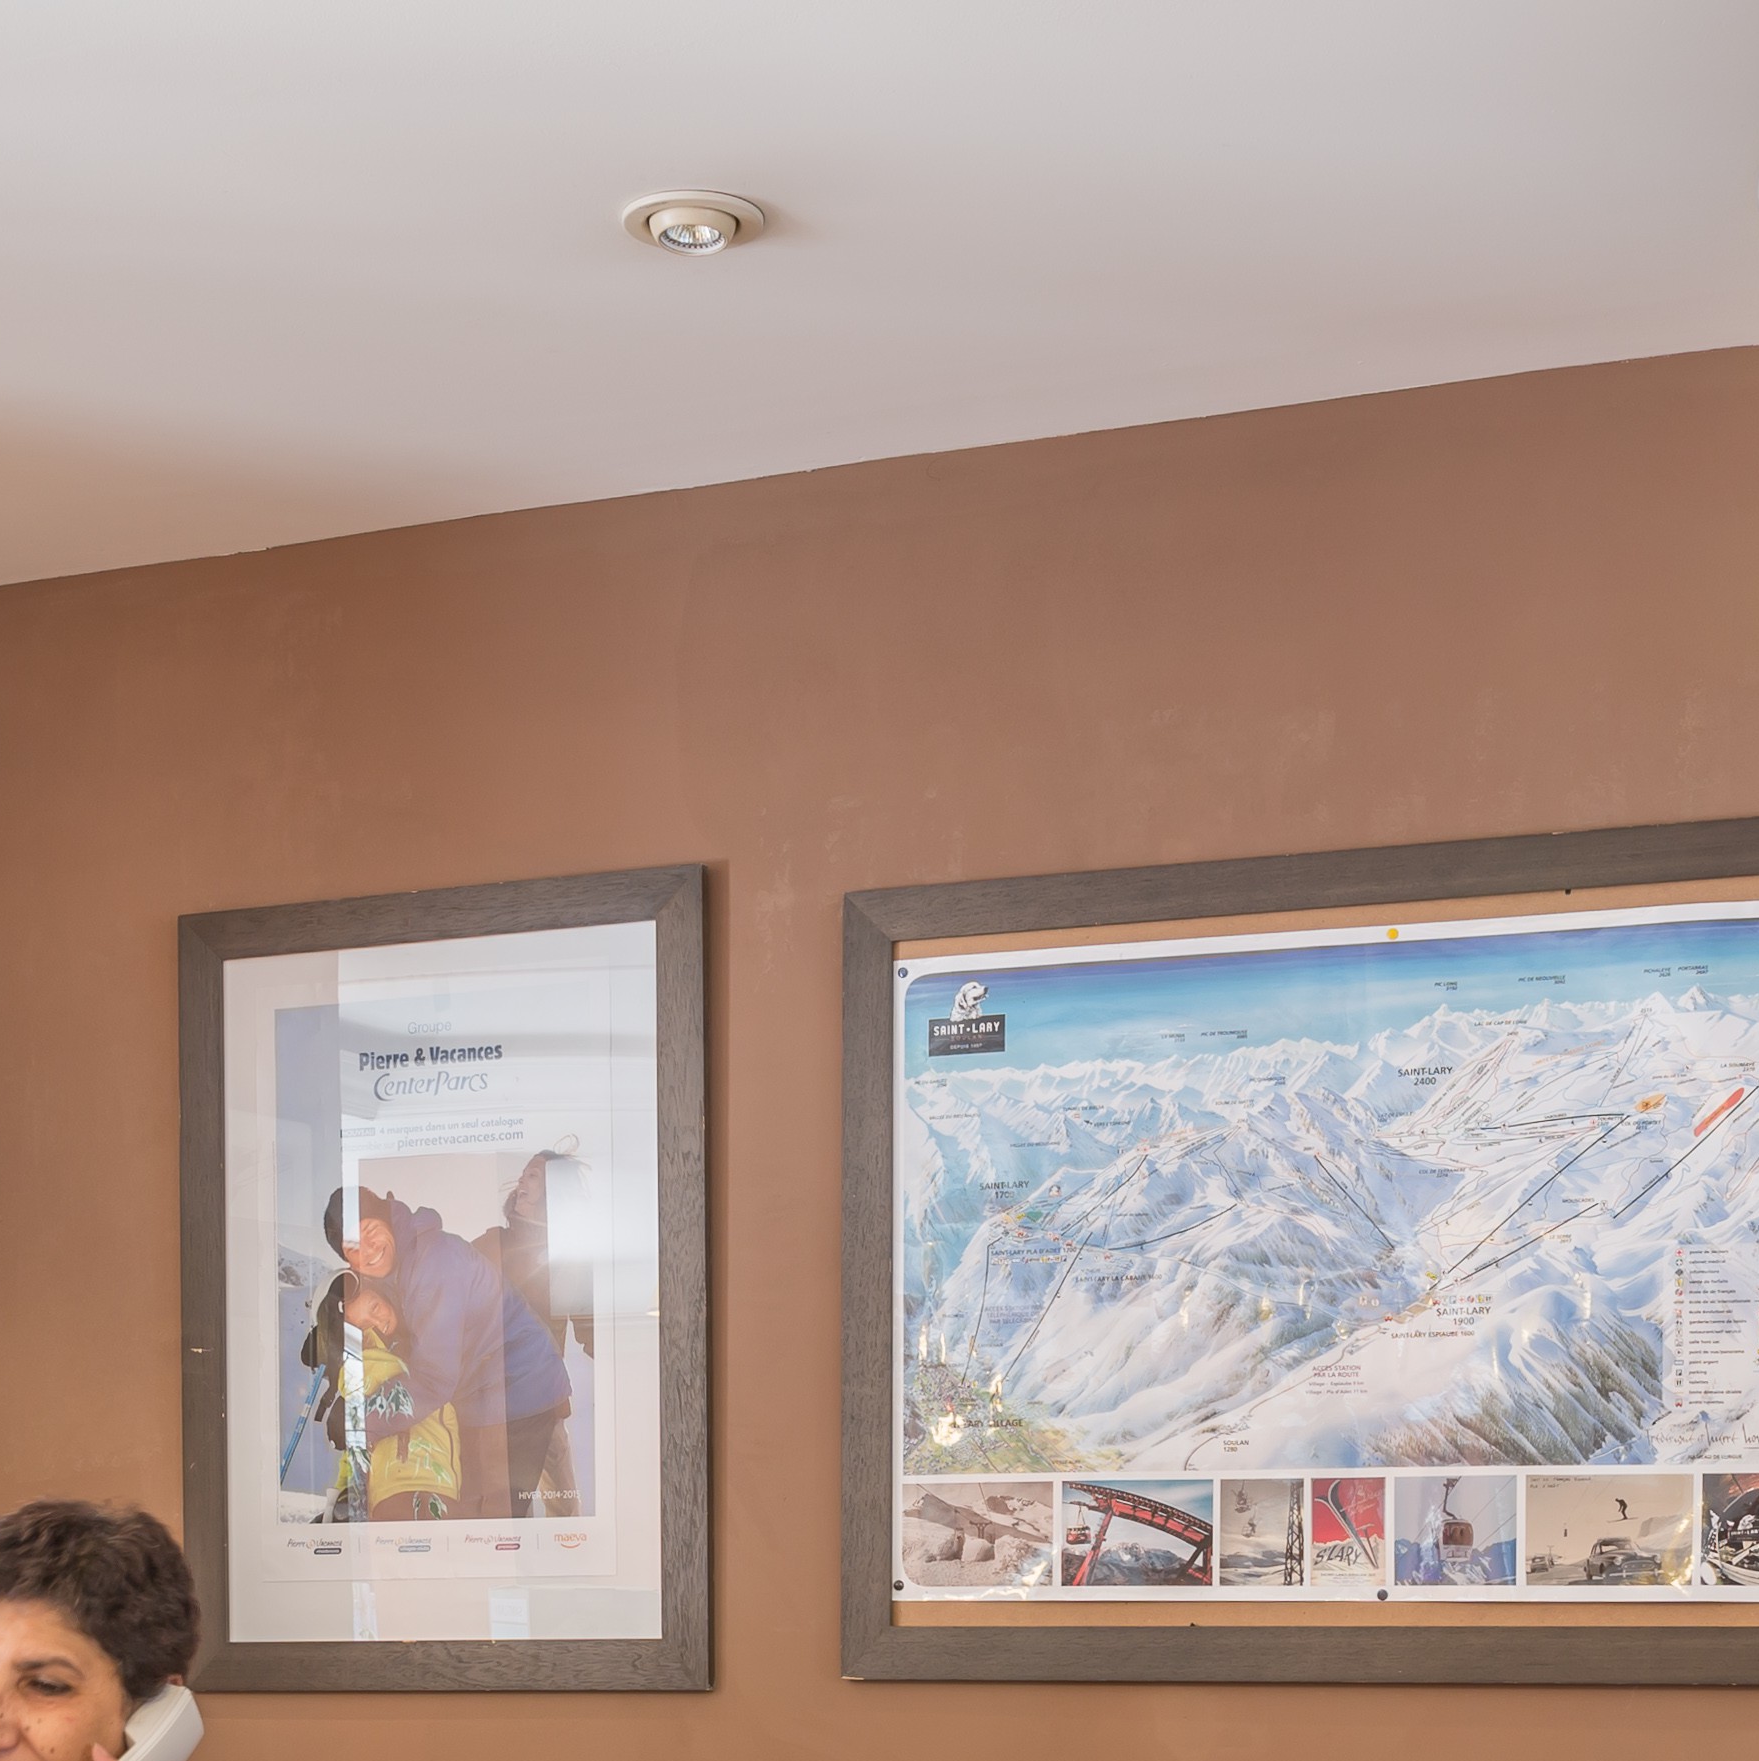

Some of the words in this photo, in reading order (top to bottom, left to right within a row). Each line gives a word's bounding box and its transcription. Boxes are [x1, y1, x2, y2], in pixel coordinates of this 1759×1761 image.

[408, 1021, 453, 1035] Groupe
[359, 1049, 409, 1071] Pierre
[414, 1048, 426, 1067] &
[429, 1044, 503, 1066] Vacances
[1397, 1066, 1453, 1078] SAINT-LARY
[1413, 1077, 1437, 1086] 2400
[387, 1124, 424, 1136] marques
[425, 1121, 445, 1132] dans
[447, 1122, 459, 1131] un
[461, 1119, 479, 1130] seul
[481, 1116, 524, 1130] catalogue
[397, 1130, 524, 1151] pierreetvacances.com
[1436, 1306, 1491, 1317] SAINT-LARY
[1453, 1317, 1475, 1326] 1900
[519, 1490, 541, 1500] HIVER
[543, 1489, 581, 1500] 2014-2015
[554, 1533, 587, 1543] maeva
